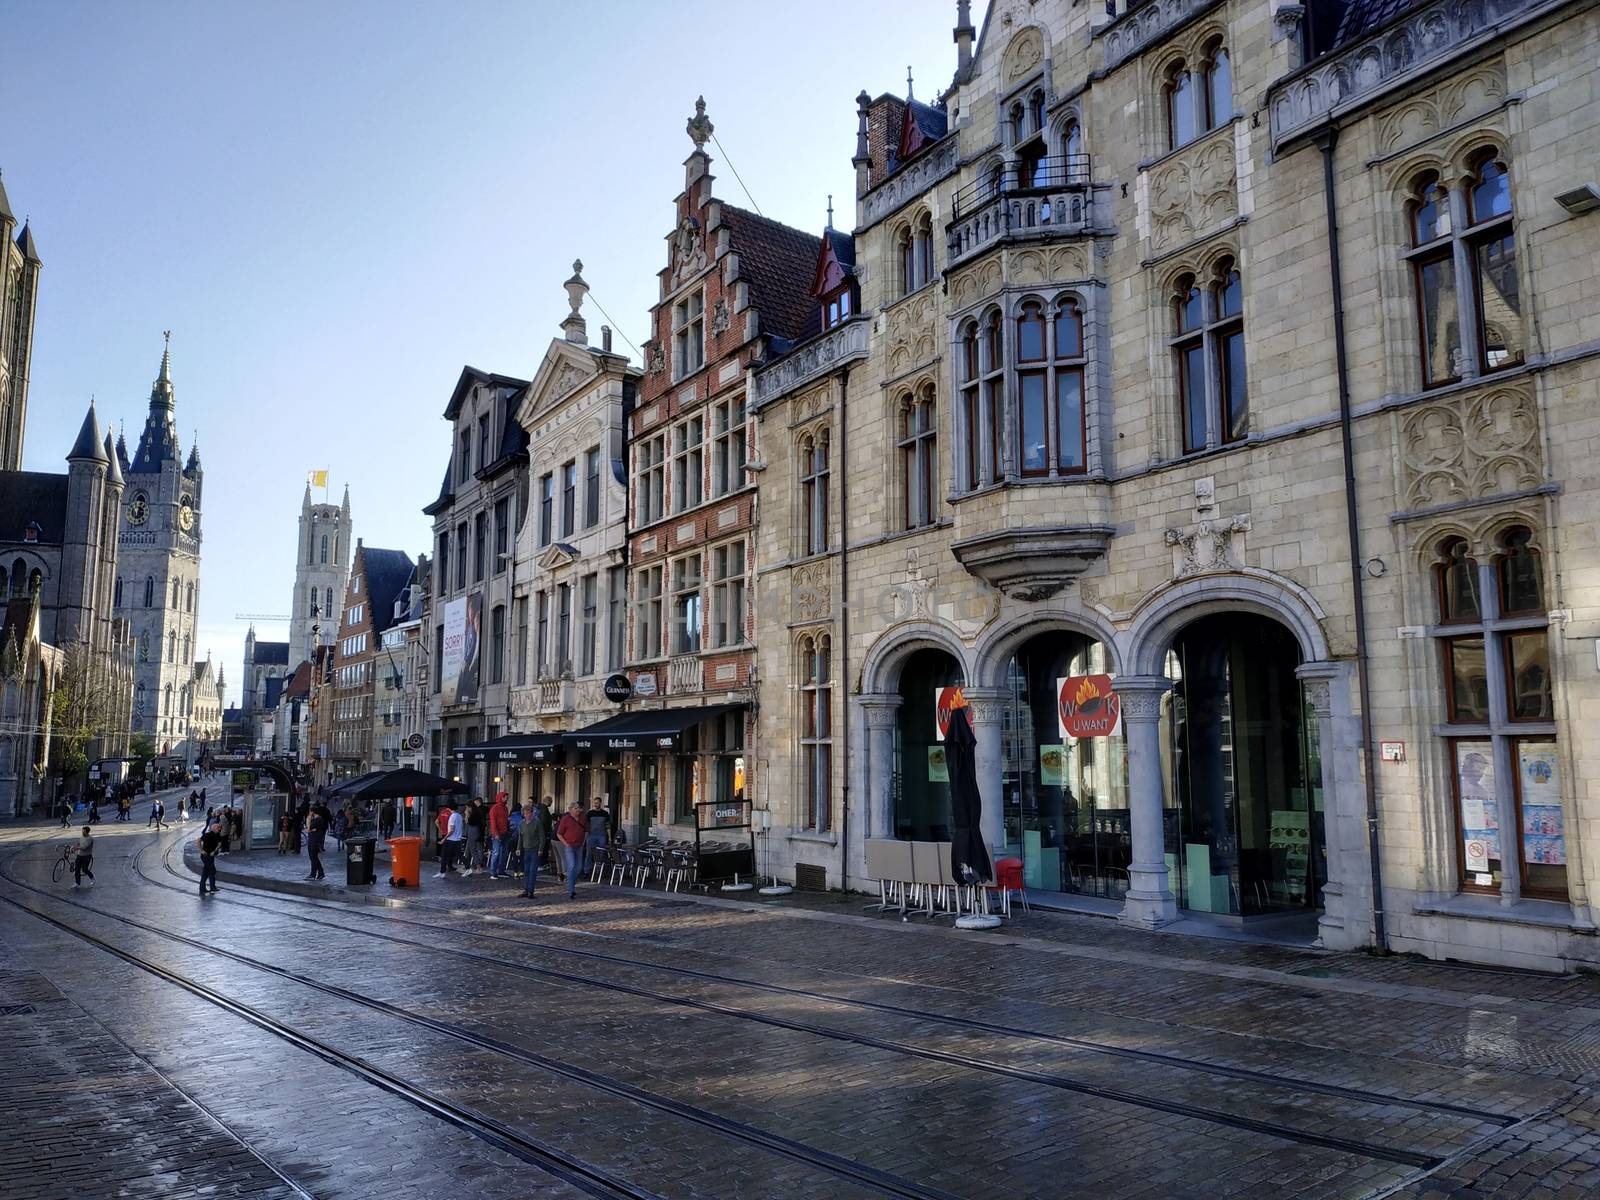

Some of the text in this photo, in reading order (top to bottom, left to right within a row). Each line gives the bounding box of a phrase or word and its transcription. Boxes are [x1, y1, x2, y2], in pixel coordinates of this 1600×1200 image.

[444, 634, 464, 650] SORRY
[1073, 719, 1109, 731] U WANT
